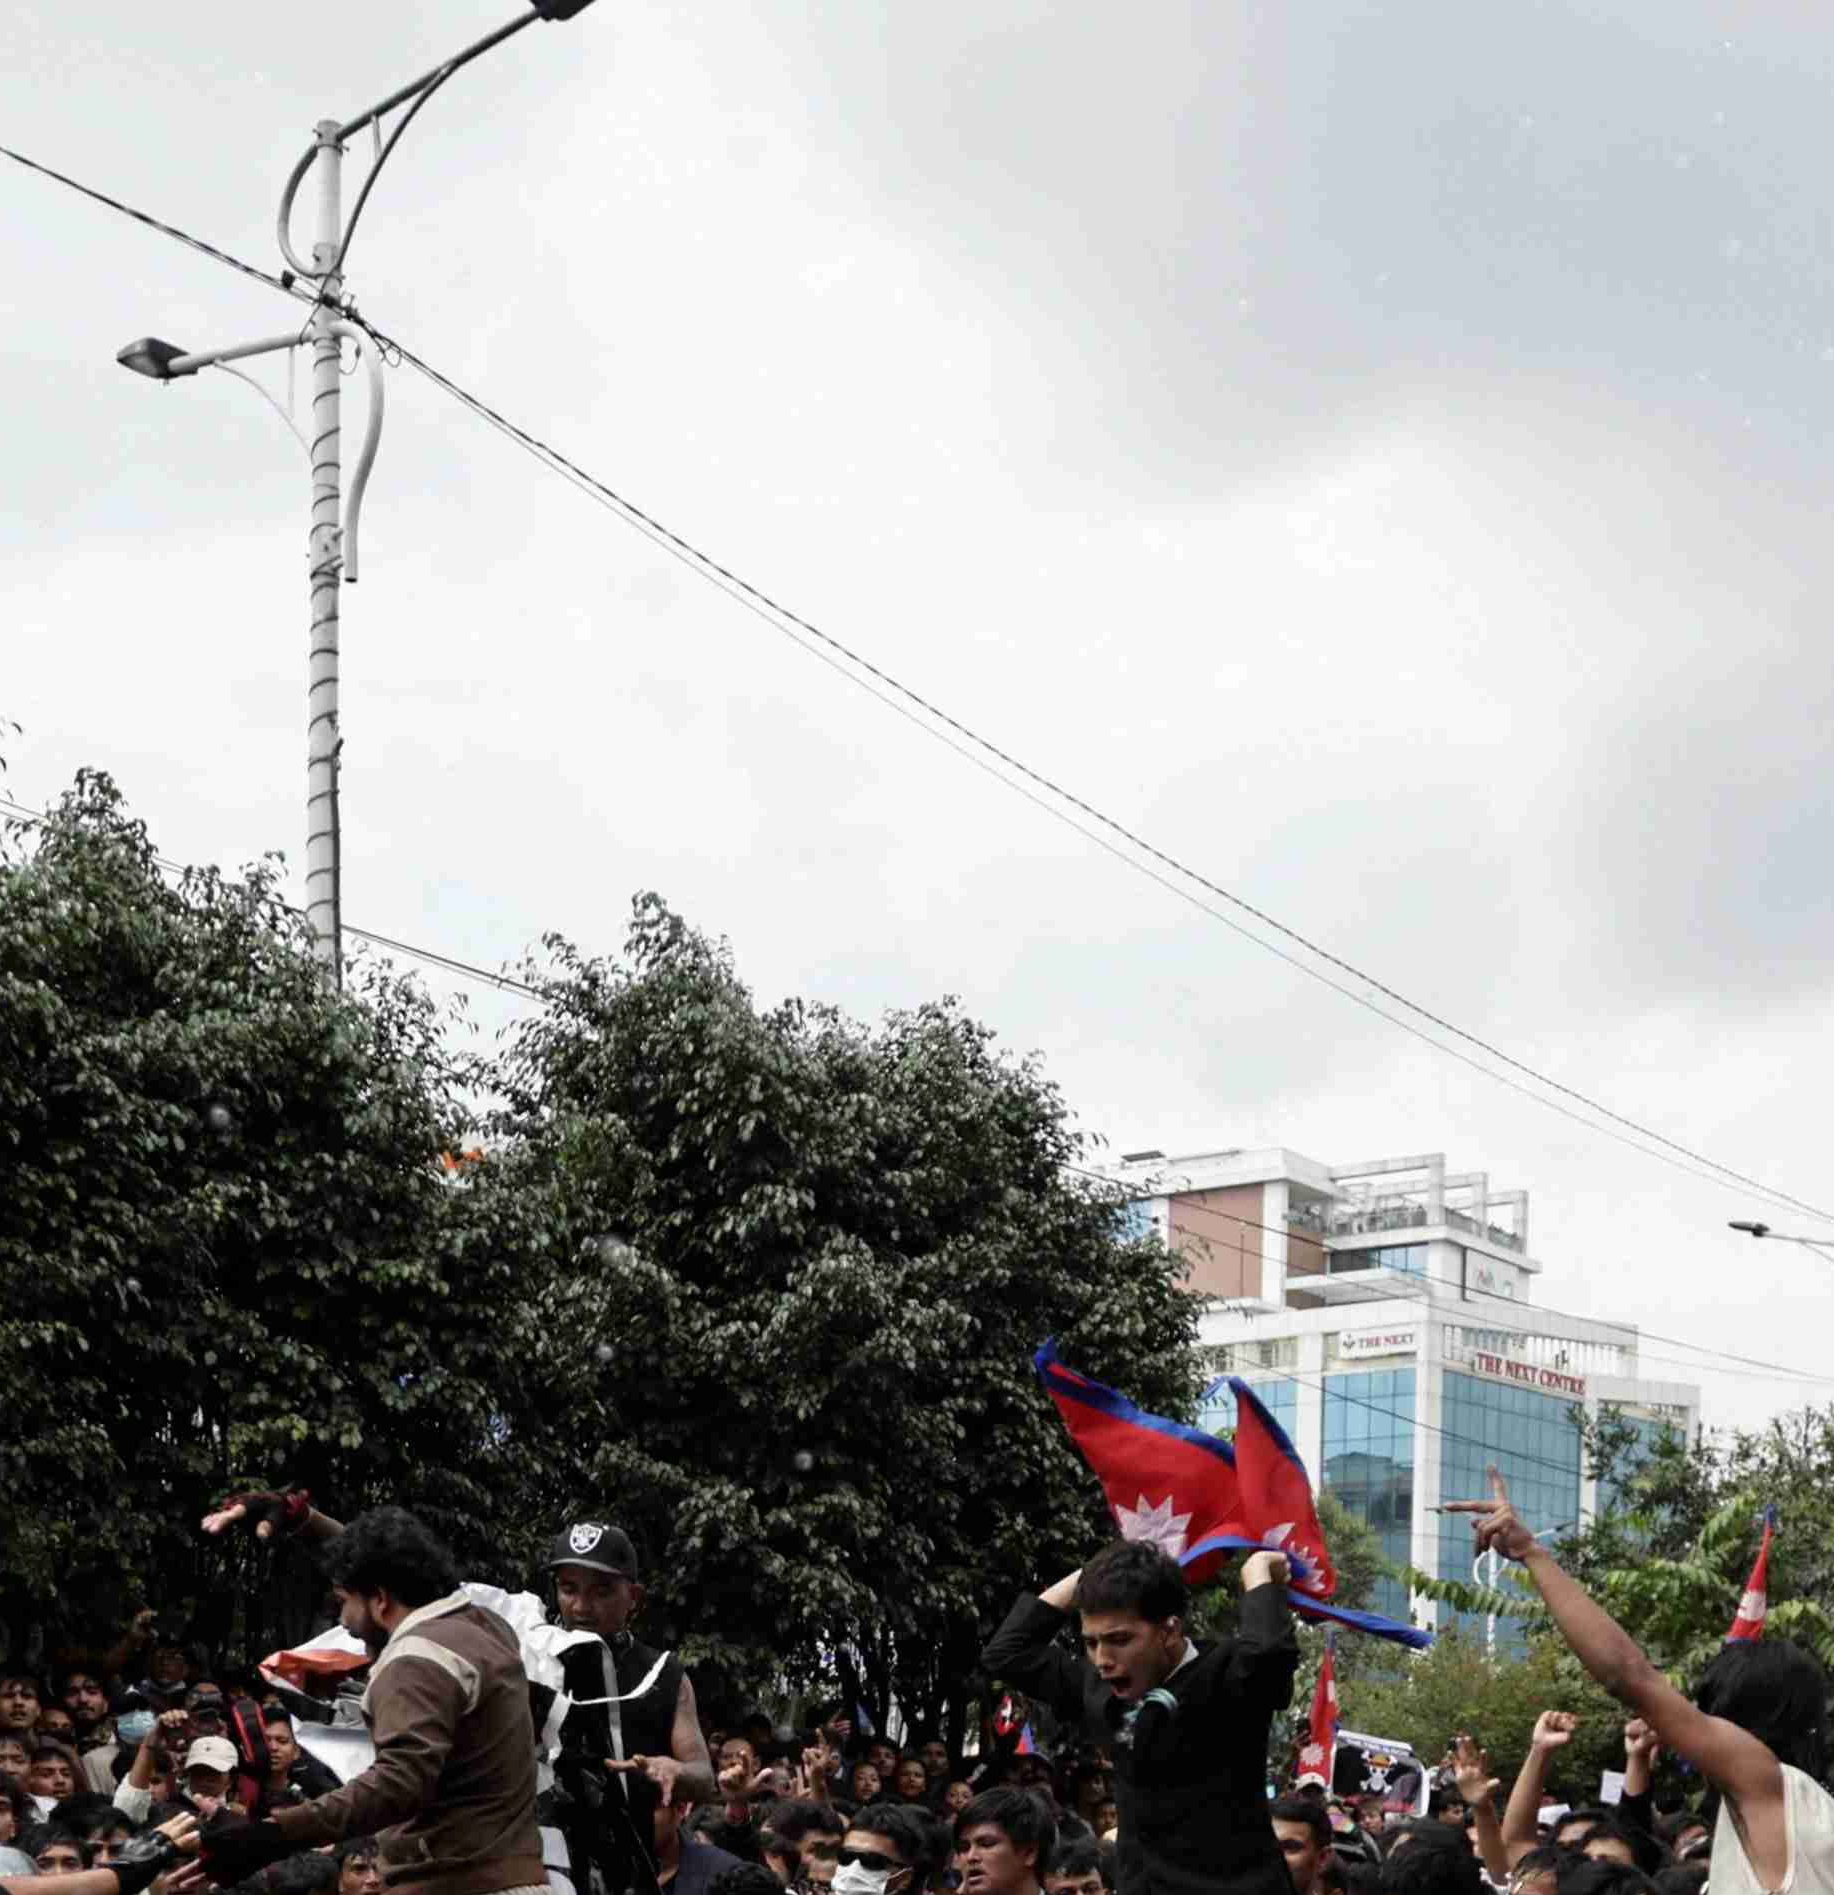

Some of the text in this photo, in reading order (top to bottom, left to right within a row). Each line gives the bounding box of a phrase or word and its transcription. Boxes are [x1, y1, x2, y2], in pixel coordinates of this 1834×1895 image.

[1477, 1352, 1585, 1396] THE NEXT CENTRE
